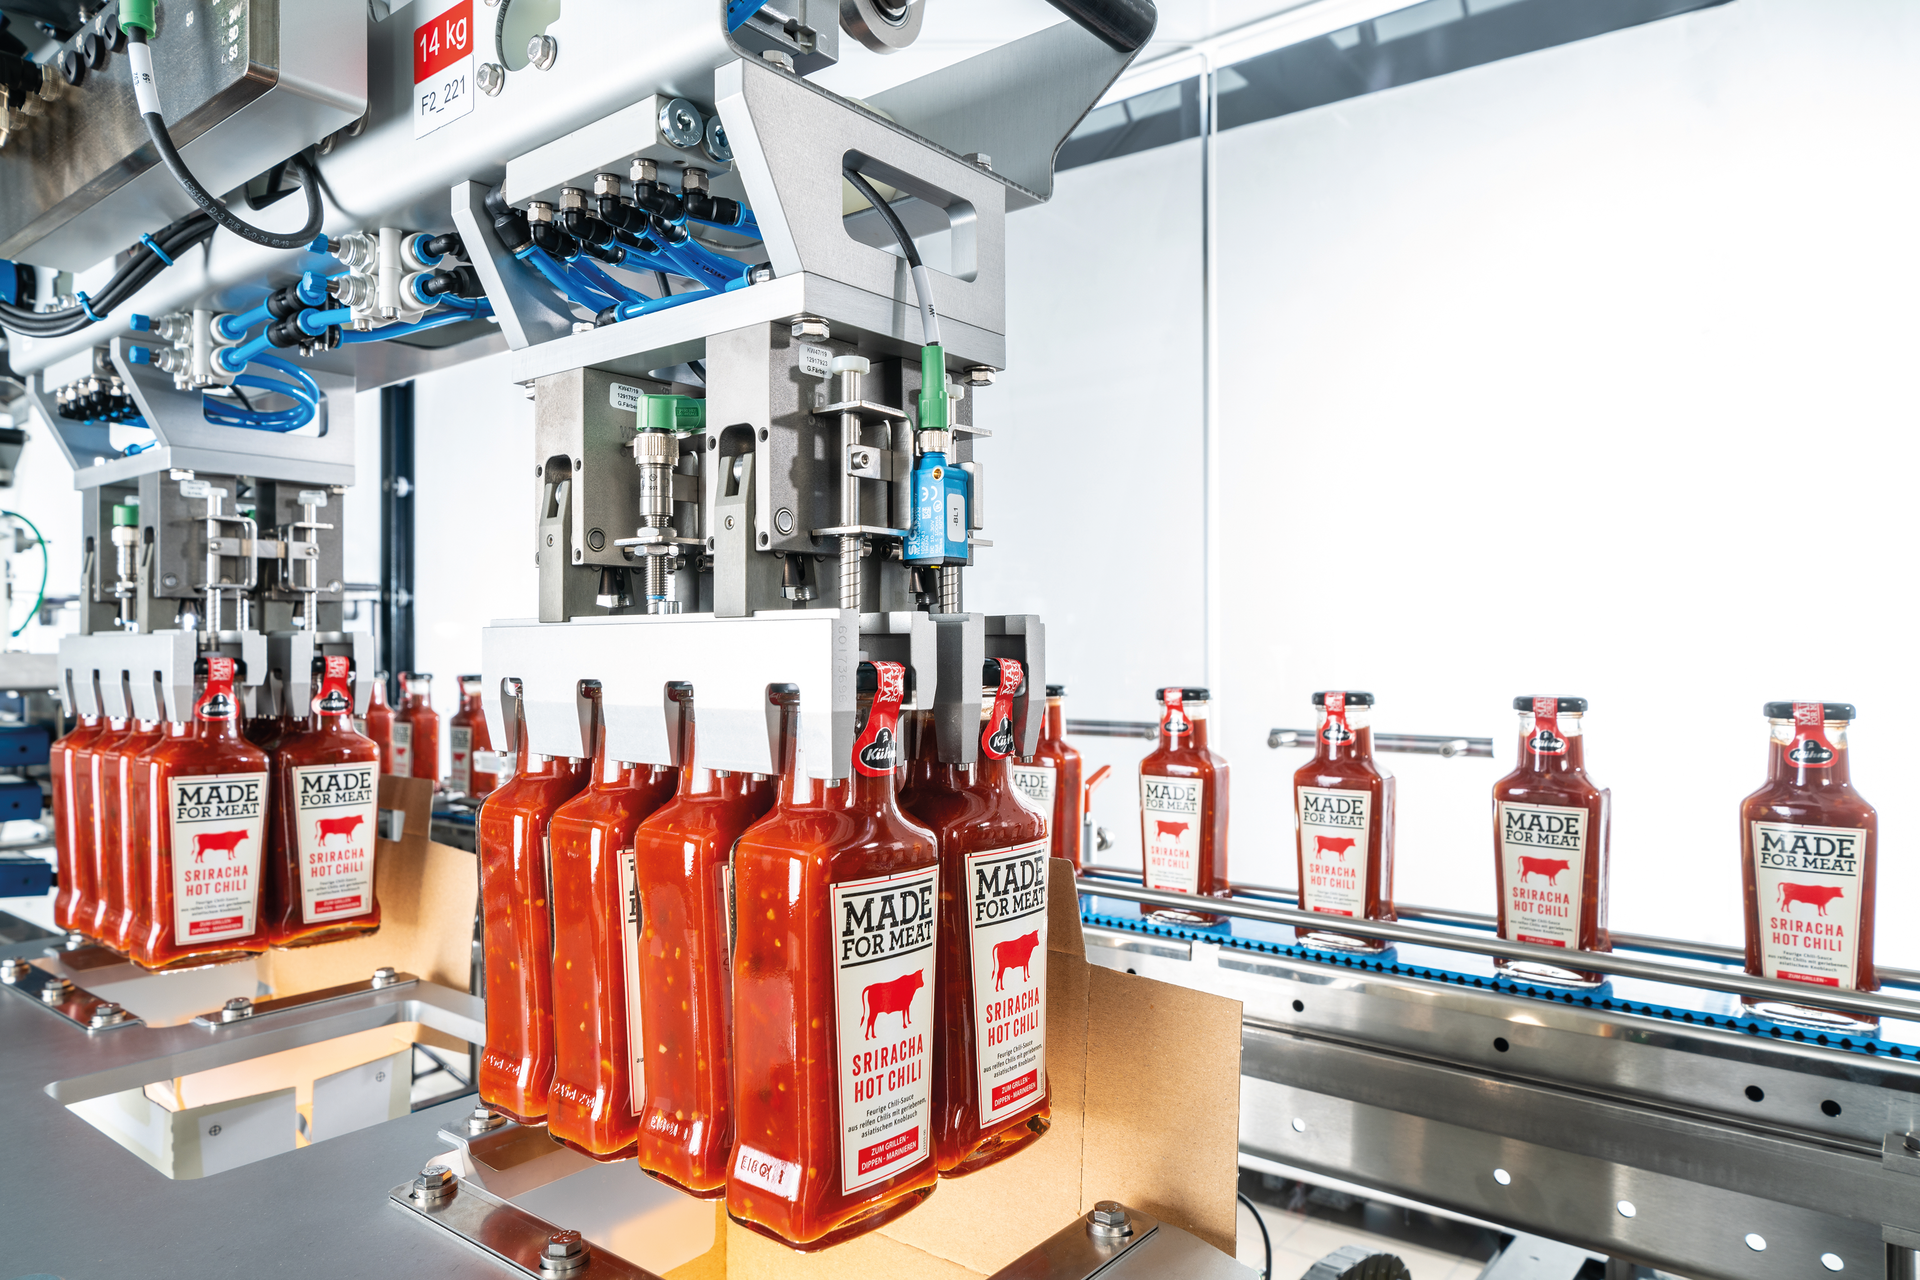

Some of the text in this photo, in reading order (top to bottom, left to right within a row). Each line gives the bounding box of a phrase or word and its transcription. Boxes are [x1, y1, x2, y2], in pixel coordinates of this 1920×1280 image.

[420, 16, 467, 62] 14 kg
[421, 74, 465, 116] F2_221
[301, 772, 371, 794] MADE
[1146, 784, 1196, 801] MADE
[177, 783, 258, 806] MADE
[301, 790, 372, 806] FOR MEAT
[1146, 798, 1197, 811] FOR MEAT
[177, 803, 259, 819] FOR MEAT
[1303, 795, 1363, 815] MADE
[1303, 811, 1364, 826] FOR MEAT
[1505, 811, 1579, 835] MADE
[1505, 829, 1580, 847] FOR MEAT
[1761, 832, 1855, 859] MADE
[309, 848, 364, 864] SRIRACHA
[1761, 852, 1857, 872] FOR MEAT
[184, 865, 248, 882] SRIRACHA
[311, 861, 363, 878] HOT CHILI
[975, 855, 1044, 901] MADE
[1309, 863, 1356, 878] SRIRACHA
[186, 879, 246, 896] HOT CHILI
[1310, 875, 1355, 890] HOT CHILI
[975, 886, 1046, 922] FOR MEAT
[1512, 887, 1570, 904] SRIRACHA
[842, 885, 932, 937] MADE
[1513, 899, 1568, 918] HOT CHILI
[1770, 917, 1844, 937] SRIRACHA
[841, 919, 933, 961] FOR MEAT
[1772, 932, 1842, 952] HOT CHILI
[986, 987, 1040, 1024] SRIRACHA
[988, 1009, 1039, 1048] HOT CHILI
[852, 1033, 924, 1076] SRIRACHA
[854, 1059, 922, 1103] HOT CHILI
[1001, 1083, 1012, 1094] ZUM
[1012, 1077, 1029, 1091] GRILLEN
[866, 1103, 887, 1117] Feurige
[994, 1095, 1011, 1107] DIPPEN
[847, 1124, 859, 1133] aus
[859, 1117, 876, 1129] reifen
[876, 1112, 892, 1124] Chilis
[892, 1108, 901, 1118] mit
[861, 1110, 918, 1138] asiatischem Knoblauch
[861, 1156, 883, 1170] DIPPEN
[886, 1140, 917, 1161] MARINIEREN
[871, 1144, 884, 1156] ZUM
[884, 1134, 906, 1151] GRILLEN
